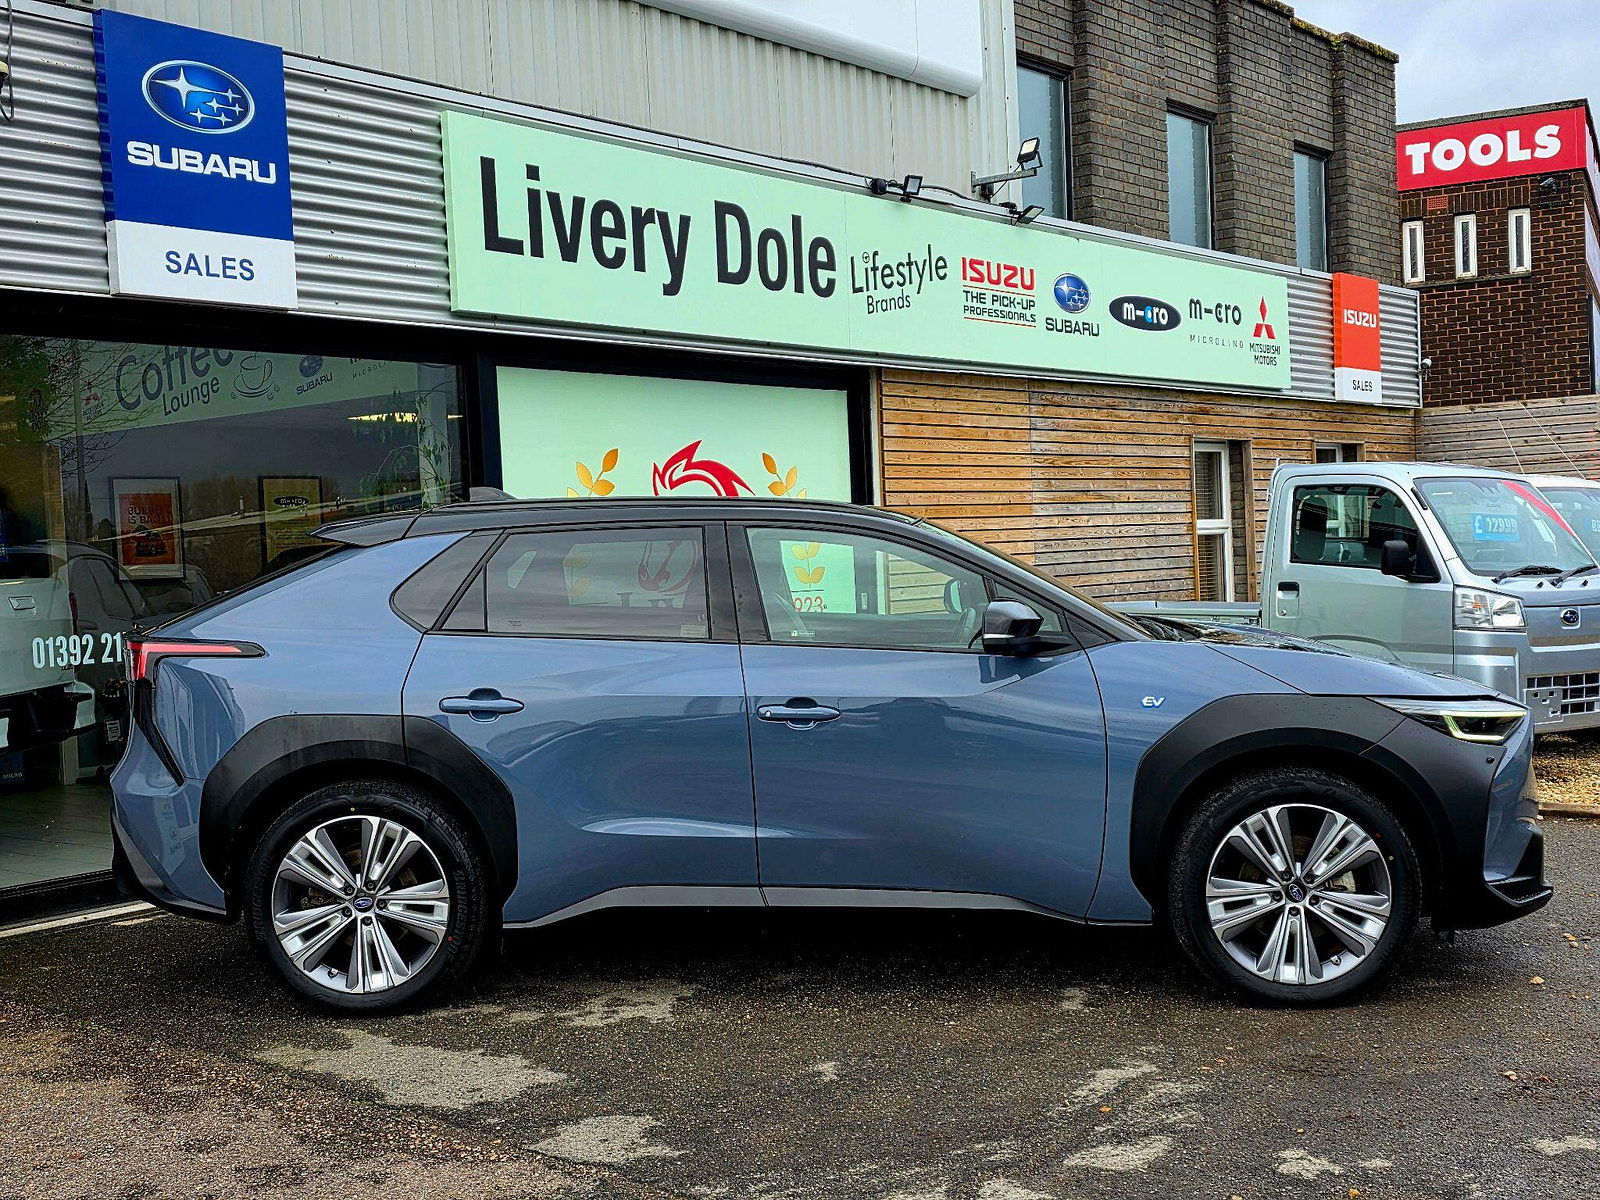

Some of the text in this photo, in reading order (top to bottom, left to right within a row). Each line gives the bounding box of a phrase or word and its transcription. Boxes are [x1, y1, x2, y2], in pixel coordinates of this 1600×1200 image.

[1405, 124, 1562, 175] TOOLS
[127, 141, 277, 185] SUBARU
[479, 156, 837, 298] Livery Dole
[165, 251, 255, 282] SALES
[850, 244, 948, 294] Lifestyle
[961, 256, 1035, 291] ISUZU
[866, 289, 912, 315] Brands
[963, 289, 1036, 311] THE PICK-UP
[963, 304, 1037, 323] PROFESSIONALS
[1344, 308, 1377, 328] ISUZU
[1045, 316, 1100, 337] SUBARU
[1190, 334, 1244, 349] MICROLINO
[1249, 342, 1281, 356] MITSUBISHI
[1254, 354, 1278, 366] MOTORS
[296, 371, 333, 395] SUBARU
[1352, 379, 1373, 393] SALES
[162, 376, 220, 416] Lounge
[32, 633, 95, 668] 01392
[1141, 696, 1166, 708] EV
